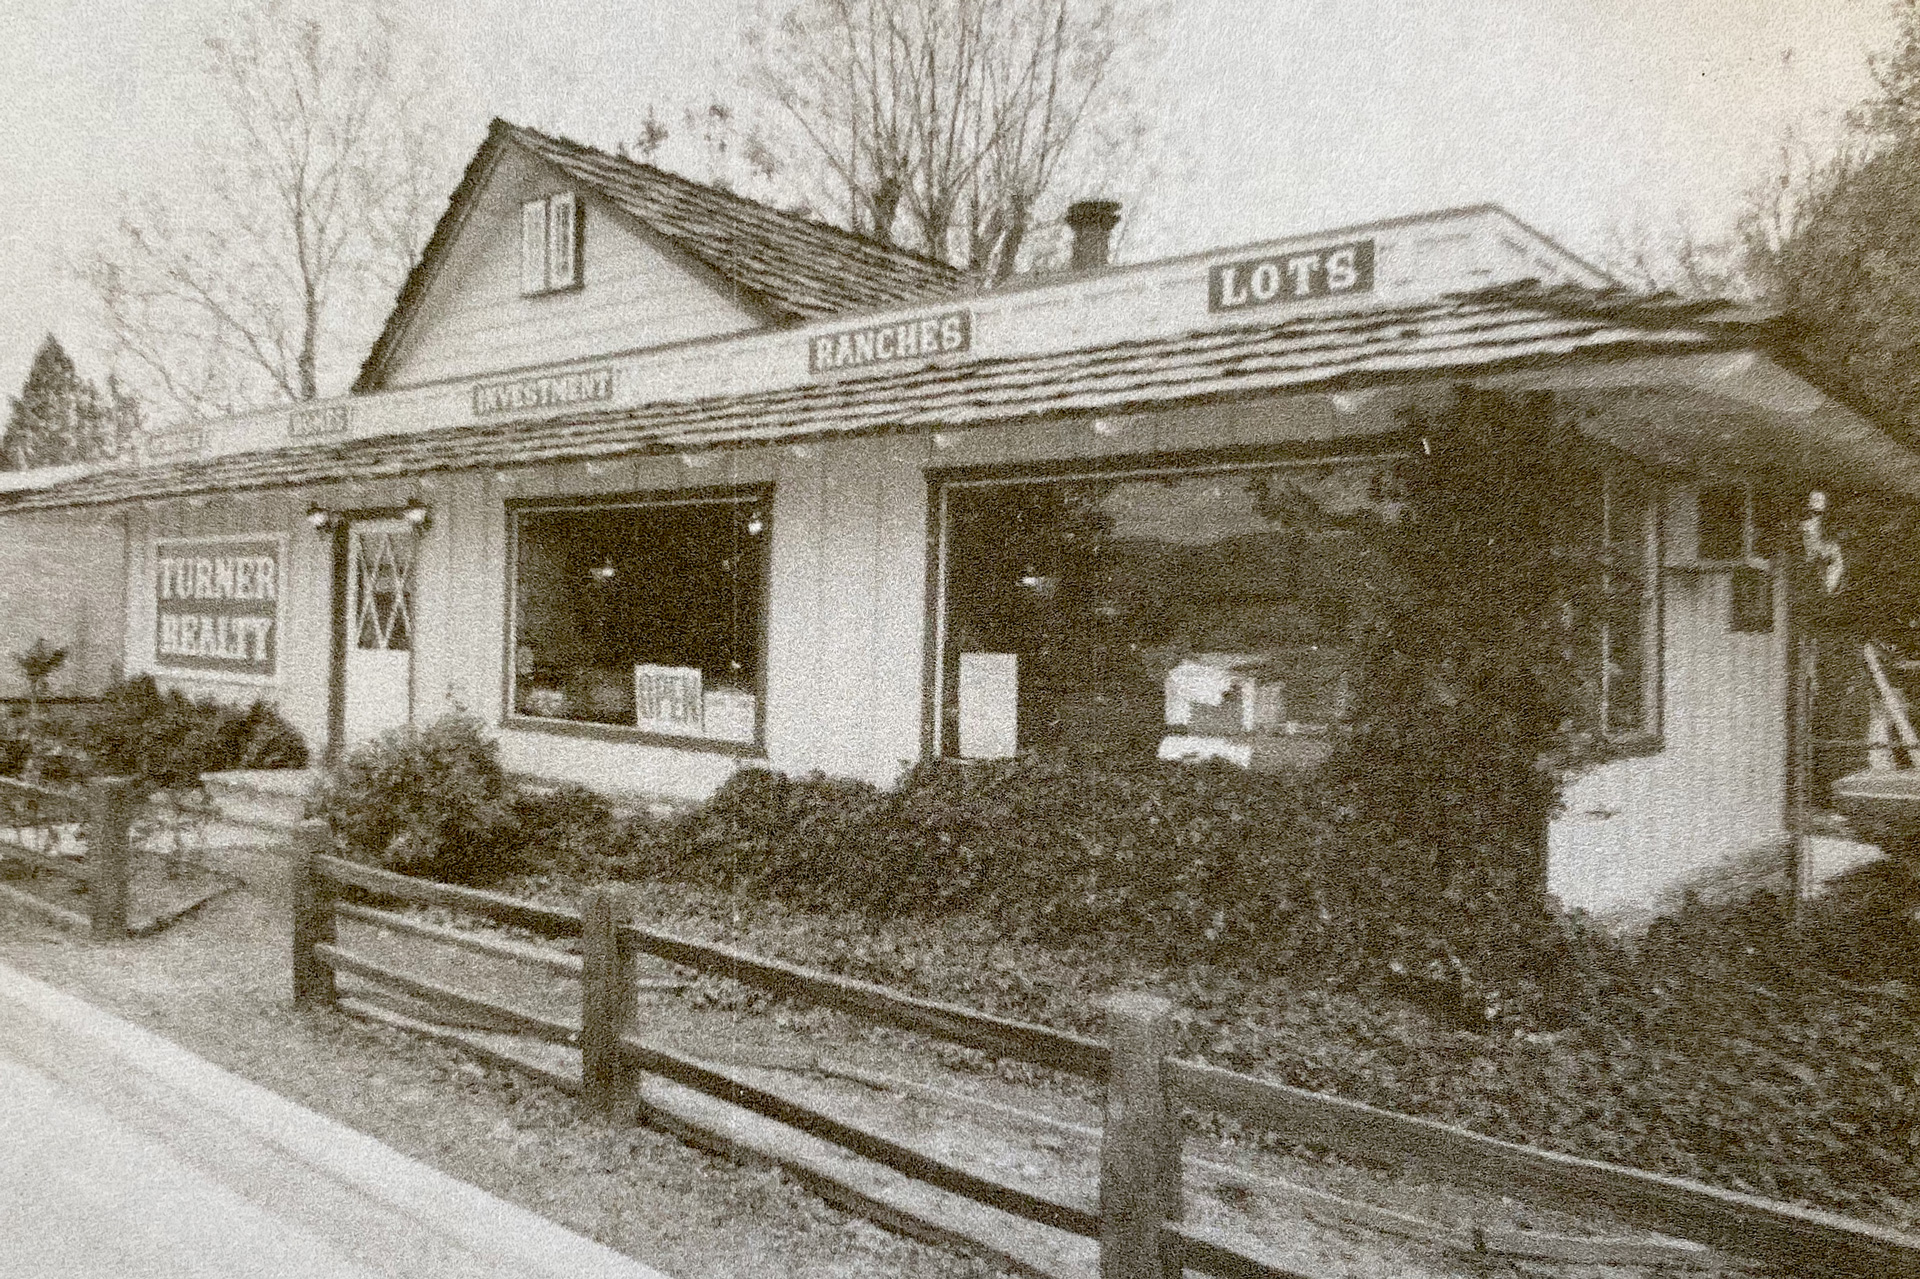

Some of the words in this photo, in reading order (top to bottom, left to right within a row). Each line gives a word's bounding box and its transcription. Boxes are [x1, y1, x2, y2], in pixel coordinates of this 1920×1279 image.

[1220, 250, 1359, 306] LOTS
[815, 316, 963, 369] RANCHES
[480, 373, 610, 414] INVESTMENT
[160, 557, 278, 599] TURNER
[160, 614, 277, 660] REALTY
[639, 673, 700, 723] OPEN
